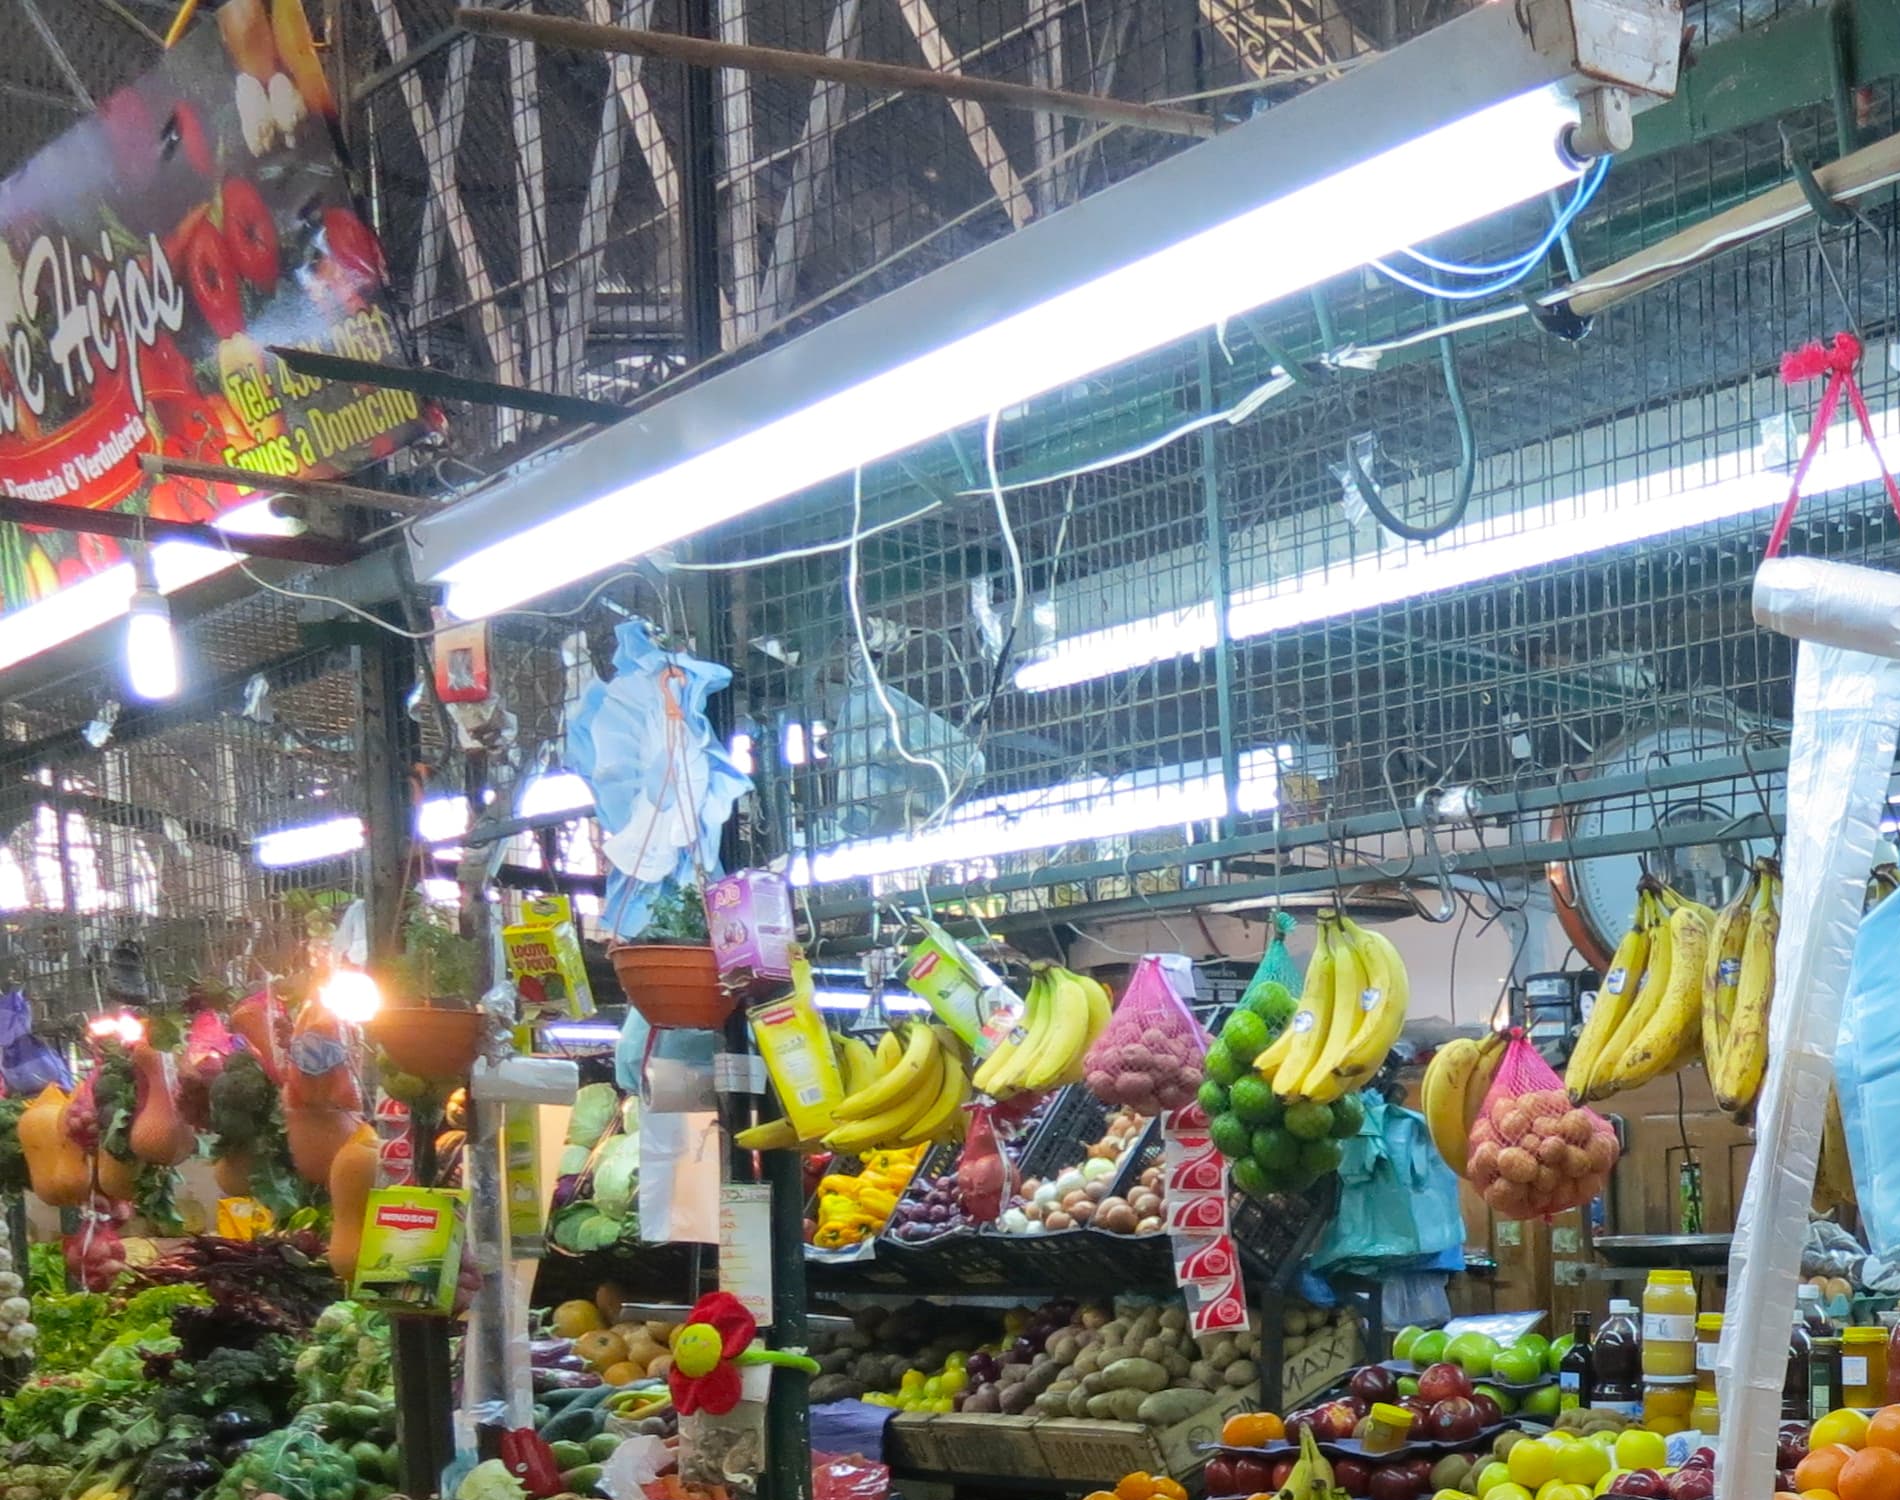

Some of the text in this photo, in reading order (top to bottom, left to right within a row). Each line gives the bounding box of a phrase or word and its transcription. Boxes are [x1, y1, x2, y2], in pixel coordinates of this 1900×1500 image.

[14, 230, 184, 416] e Hijos
[294, 426, 318, 467] a
[378, 1211, 435, 1225] WINDSOR
